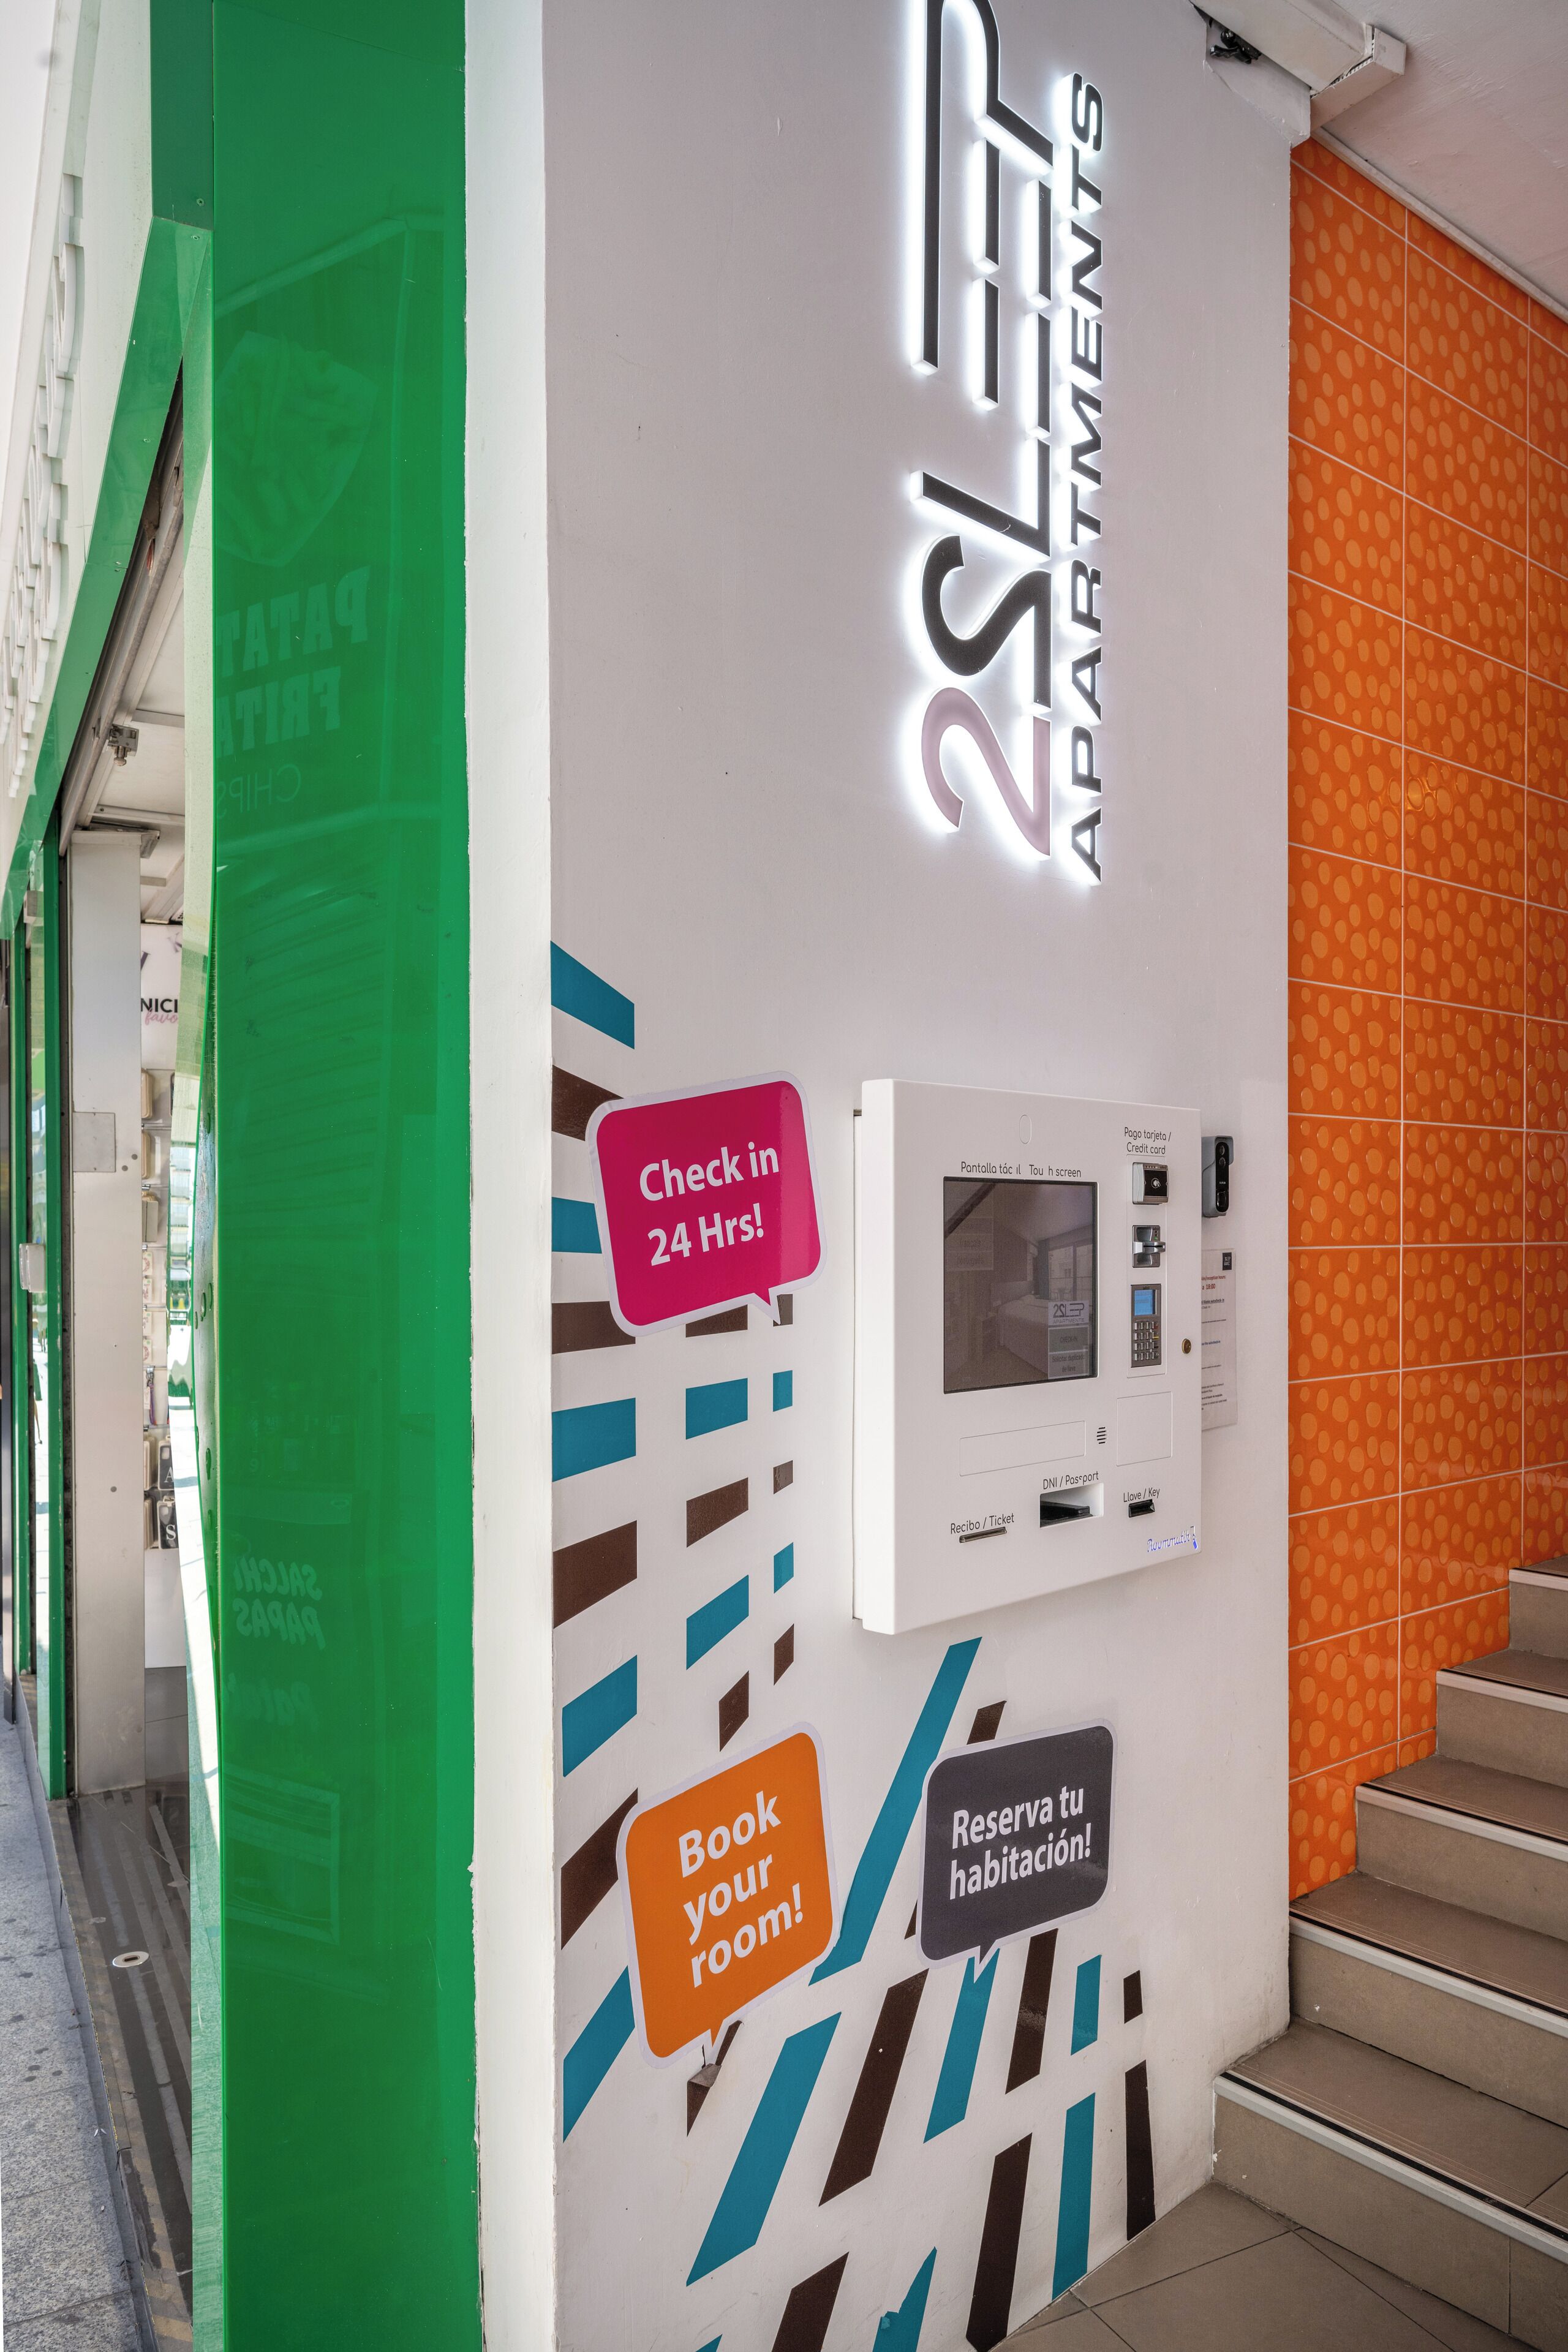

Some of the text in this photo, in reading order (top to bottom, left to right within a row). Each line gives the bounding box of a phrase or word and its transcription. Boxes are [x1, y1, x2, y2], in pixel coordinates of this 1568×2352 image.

[1071, 72, 1104, 883] APARTMENTS
[1124, 1126, 1142, 1140] Pago
[1144, 1129, 1167, 1142] tarjeta
[1126, 1142, 1166, 1155] Credit card
[639, 1141, 780, 1202] Check in
[961, 1161, 997, 1173] Pantalla
[1055, 1169, 1082, 1177] screen
[647, 1202, 764, 1267] 24 Hrs!
[1043, 1477, 1057, 1490] DNI
[1123, 1491, 1142, 1502] Llave
[1148, 1487, 1160, 1499] Key
[166, 1524, 177, 1540] S
[951, 1520, 980, 1534] Recibo
[989, 1513, 1014, 1526] Ticket
[678, 1790, 782, 1879] Book
[952, 1785, 1084, 1850] Reserva tu
[949, 1822, 1092, 1900] habitación!
[683, 1853, 774, 1946] your
[691, 1882, 804, 1988] room!
